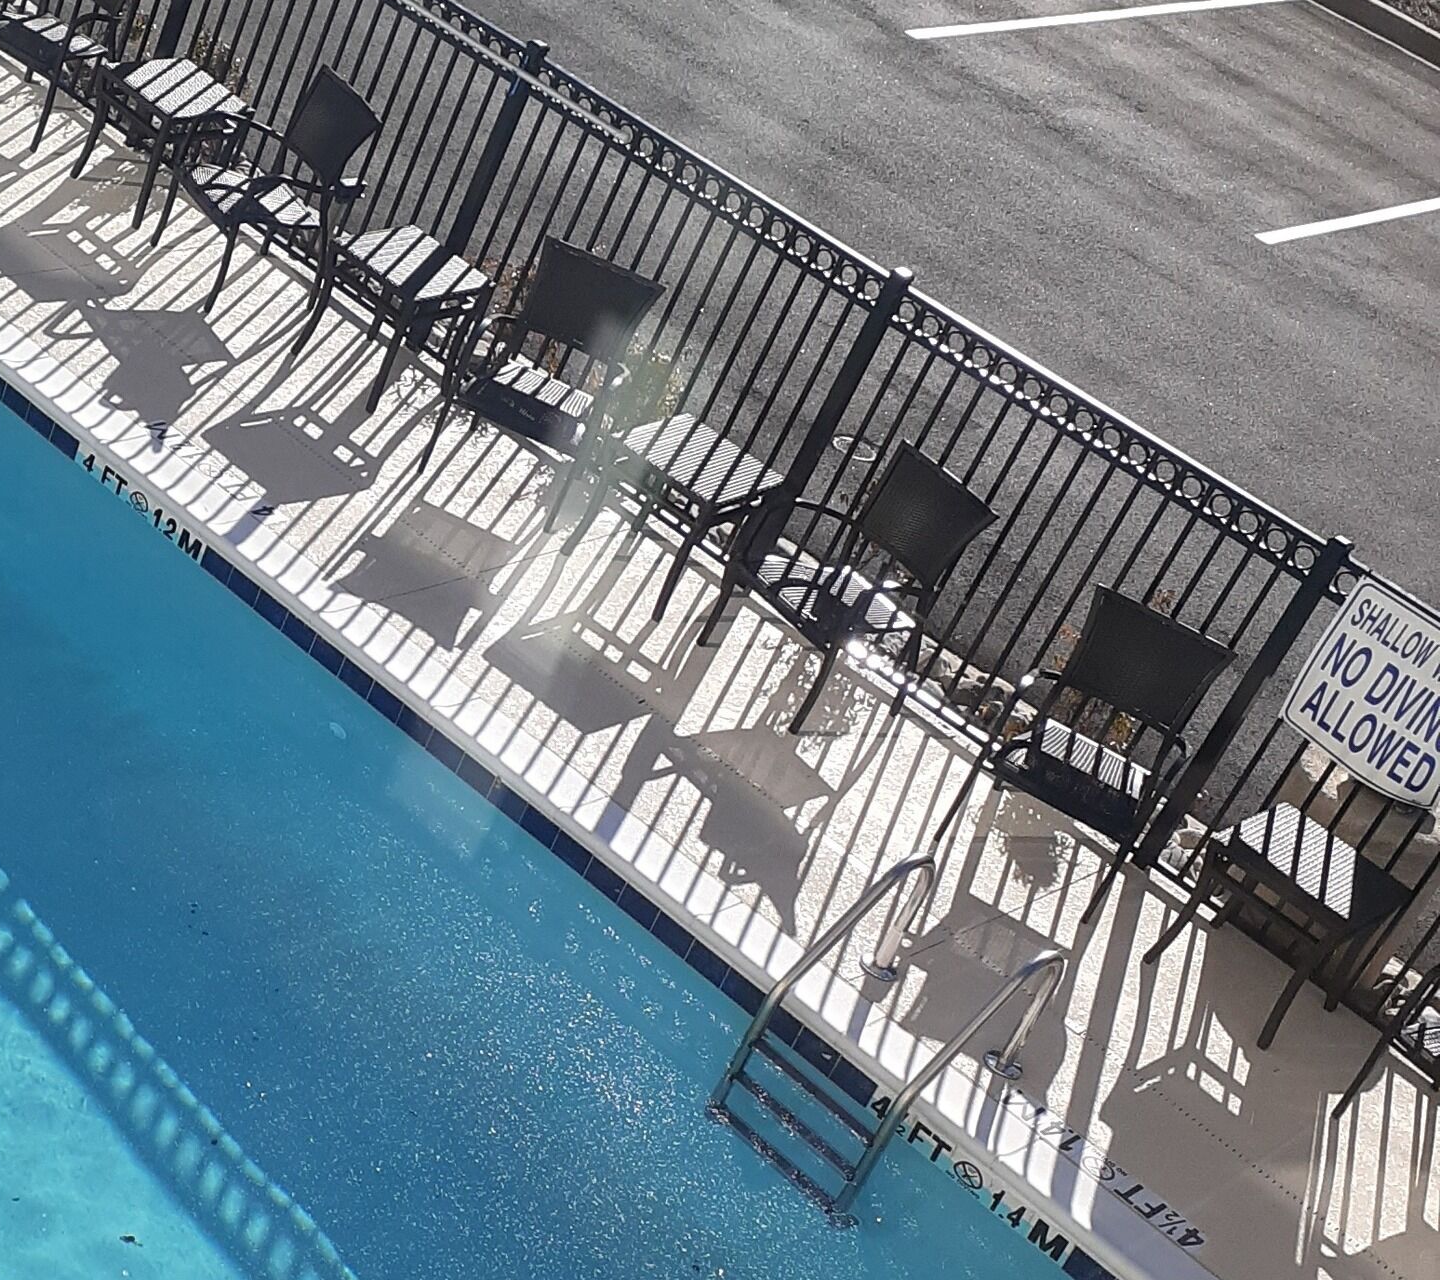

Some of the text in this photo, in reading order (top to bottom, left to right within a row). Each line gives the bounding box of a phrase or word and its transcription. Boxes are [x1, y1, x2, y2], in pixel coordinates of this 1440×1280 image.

[82, 453, 96, 473] 4
[101, 465, 128, 496] FT
[177, 528, 203, 562] M
[1350, 598, 1440, 669] SHALLOW
[1300, 680, 1436, 793] ALLOWED
[1320, 632, 1440, 753] NO DIVIN
[907, 1121, 952, 1162] FT
[1027, 1218, 1069, 1262] M
